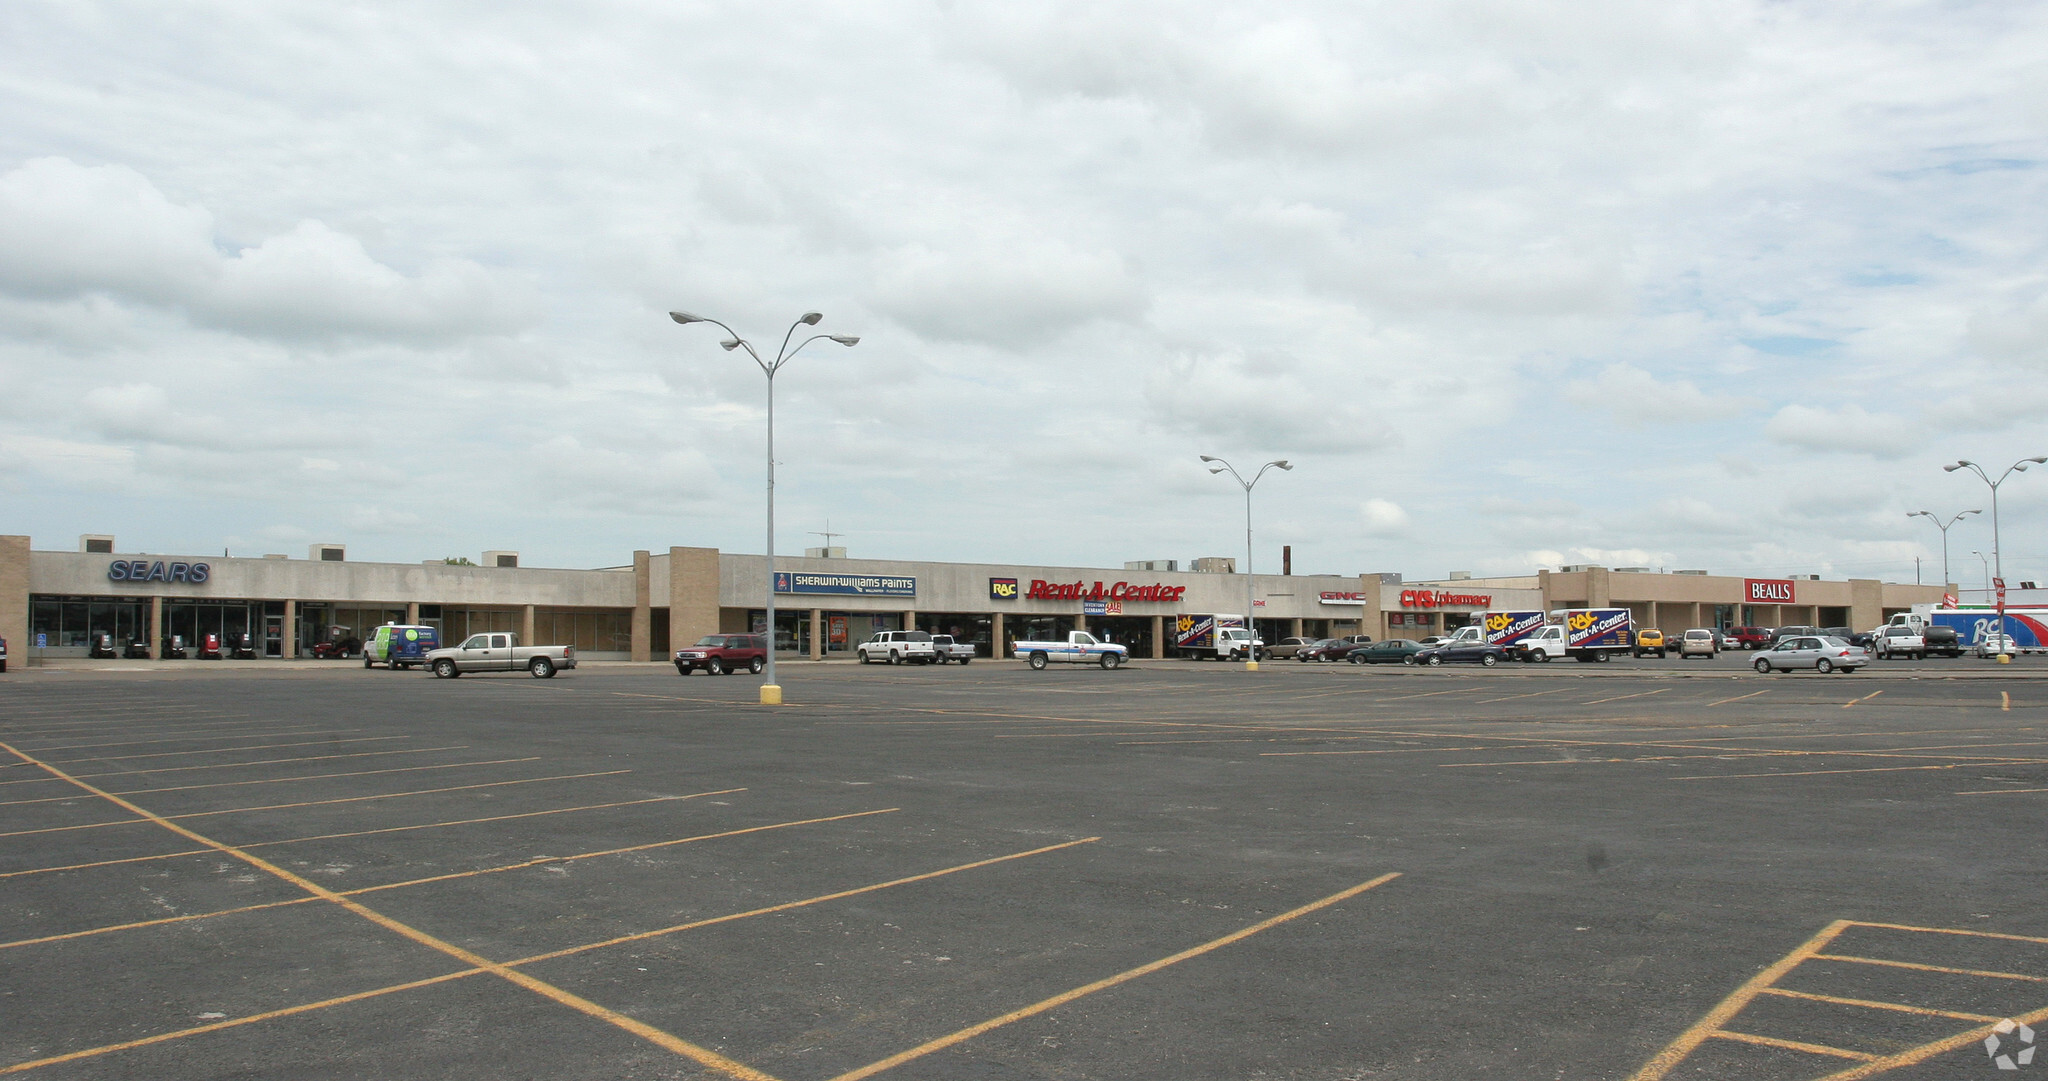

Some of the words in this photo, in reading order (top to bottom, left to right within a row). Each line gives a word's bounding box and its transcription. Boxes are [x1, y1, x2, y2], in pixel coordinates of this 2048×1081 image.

[107, 560, 210, 583] SEARS
[993, 583, 1016, 597] RAC
[1320, 591, 1366, 601] GNC
[1752, 583, 1791, 600] BEALLS
[1400, 590, 1492, 609] CVS/pharmacy
[1177, 615, 1196, 632] RAC
[1486, 612, 1514, 632] RAC
[1568, 611, 1598, 632] RAC
